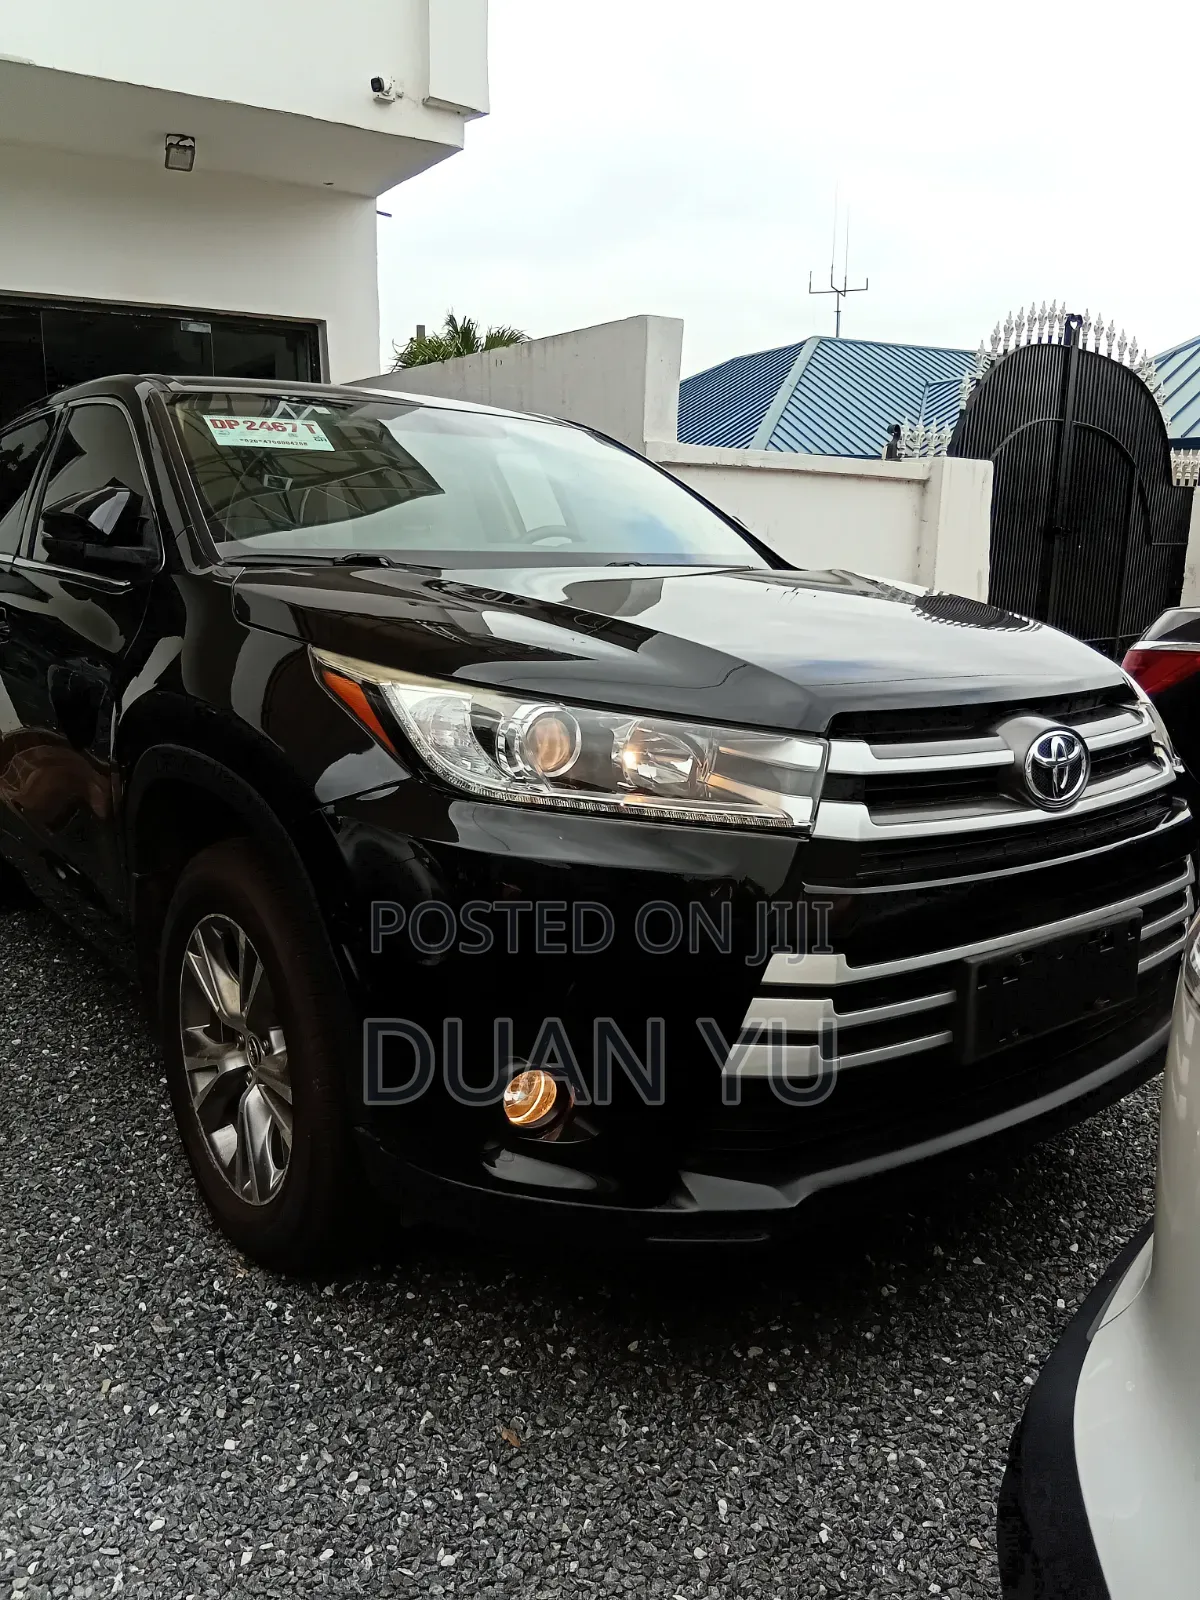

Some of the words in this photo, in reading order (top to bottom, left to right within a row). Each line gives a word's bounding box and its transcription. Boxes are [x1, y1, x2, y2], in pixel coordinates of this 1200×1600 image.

[210, 419, 240, 430] DP
[243, 420, 298, 433] 2467
[301, 423, 316, 434] T
